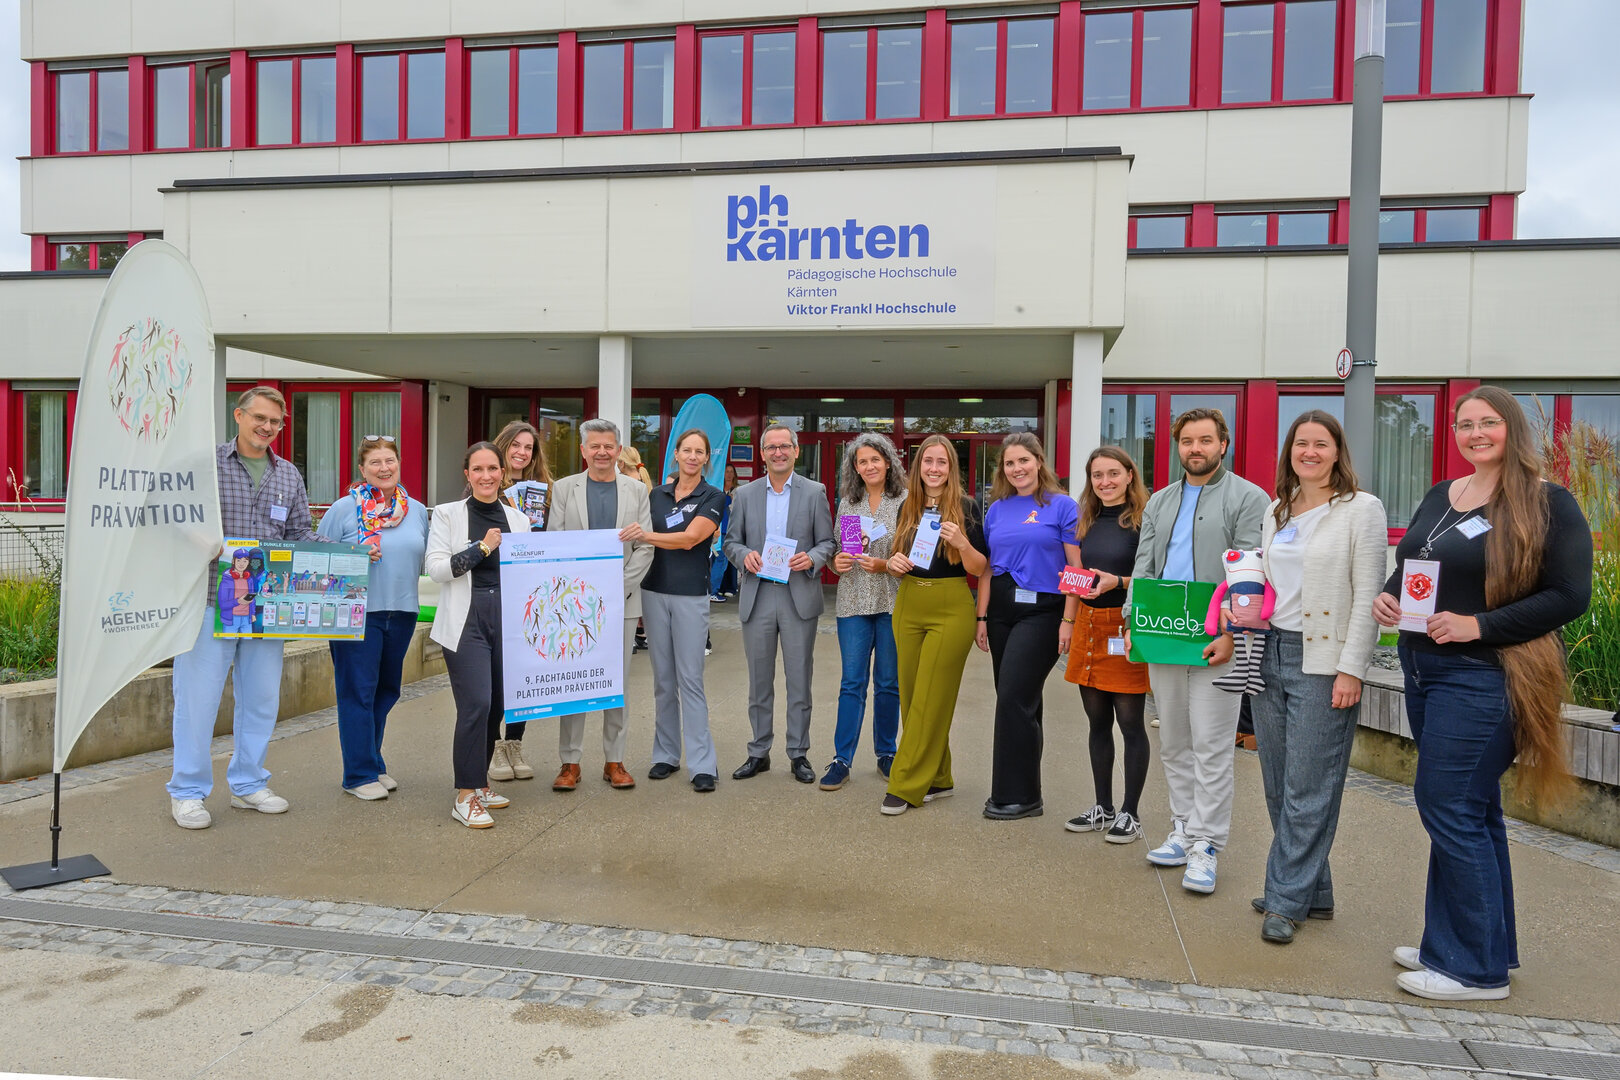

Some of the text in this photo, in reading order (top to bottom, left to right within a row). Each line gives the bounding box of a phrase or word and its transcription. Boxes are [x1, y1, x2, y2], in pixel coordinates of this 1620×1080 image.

[727, 185, 789, 239] ph
[727, 219, 930, 261] kärnten
[787, 266, 957, 282] Pädagogische Hochschule
[787, 287, 838, 298] Kärnten
[787, 302, 957, 316] Viktor Frankl Hochschule
[1061, 571, 1093, 589] POSITIV?
[1135, 606, 1199, 632] bvaeb
[525, 667, 605, 685] 9. FACHTAGUNG DER
[516, 679, 613, 699] PLATTFORM PRÄVENTION
